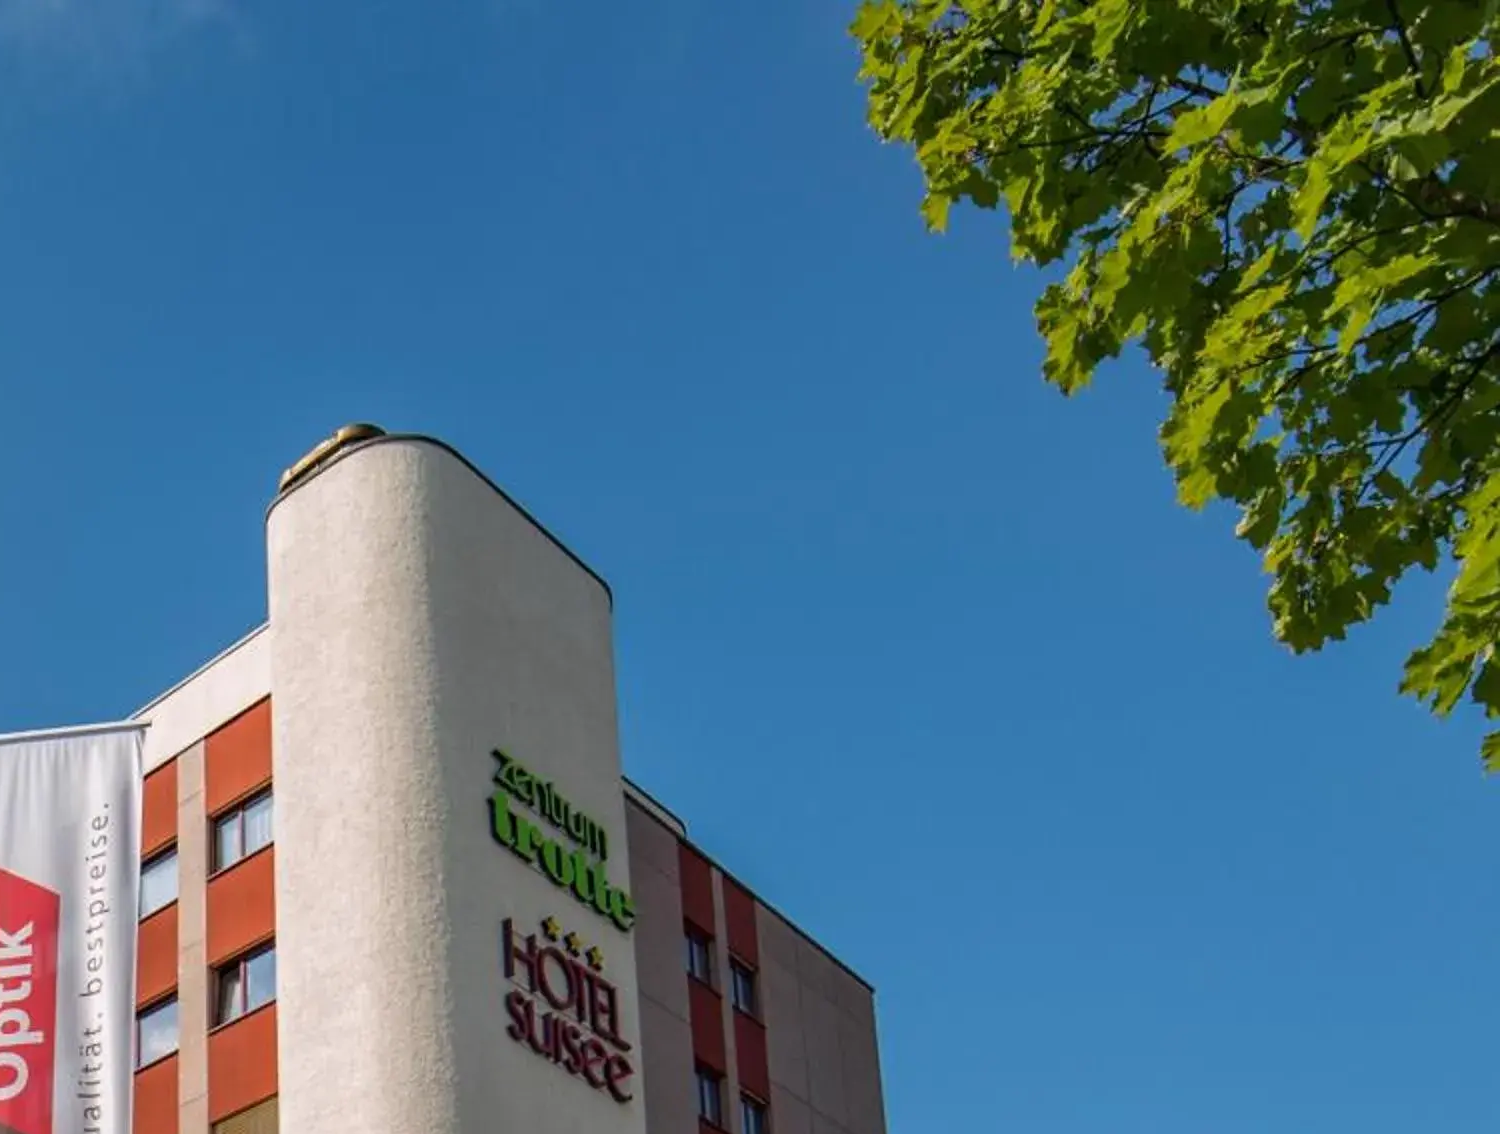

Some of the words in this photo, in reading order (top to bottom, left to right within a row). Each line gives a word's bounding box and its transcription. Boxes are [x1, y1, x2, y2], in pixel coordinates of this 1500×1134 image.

[79, 801, 110, 999] bestpreise.
[487, 790, 636, 932] trotte
[503, 917, 631, 1051] HOTEL
